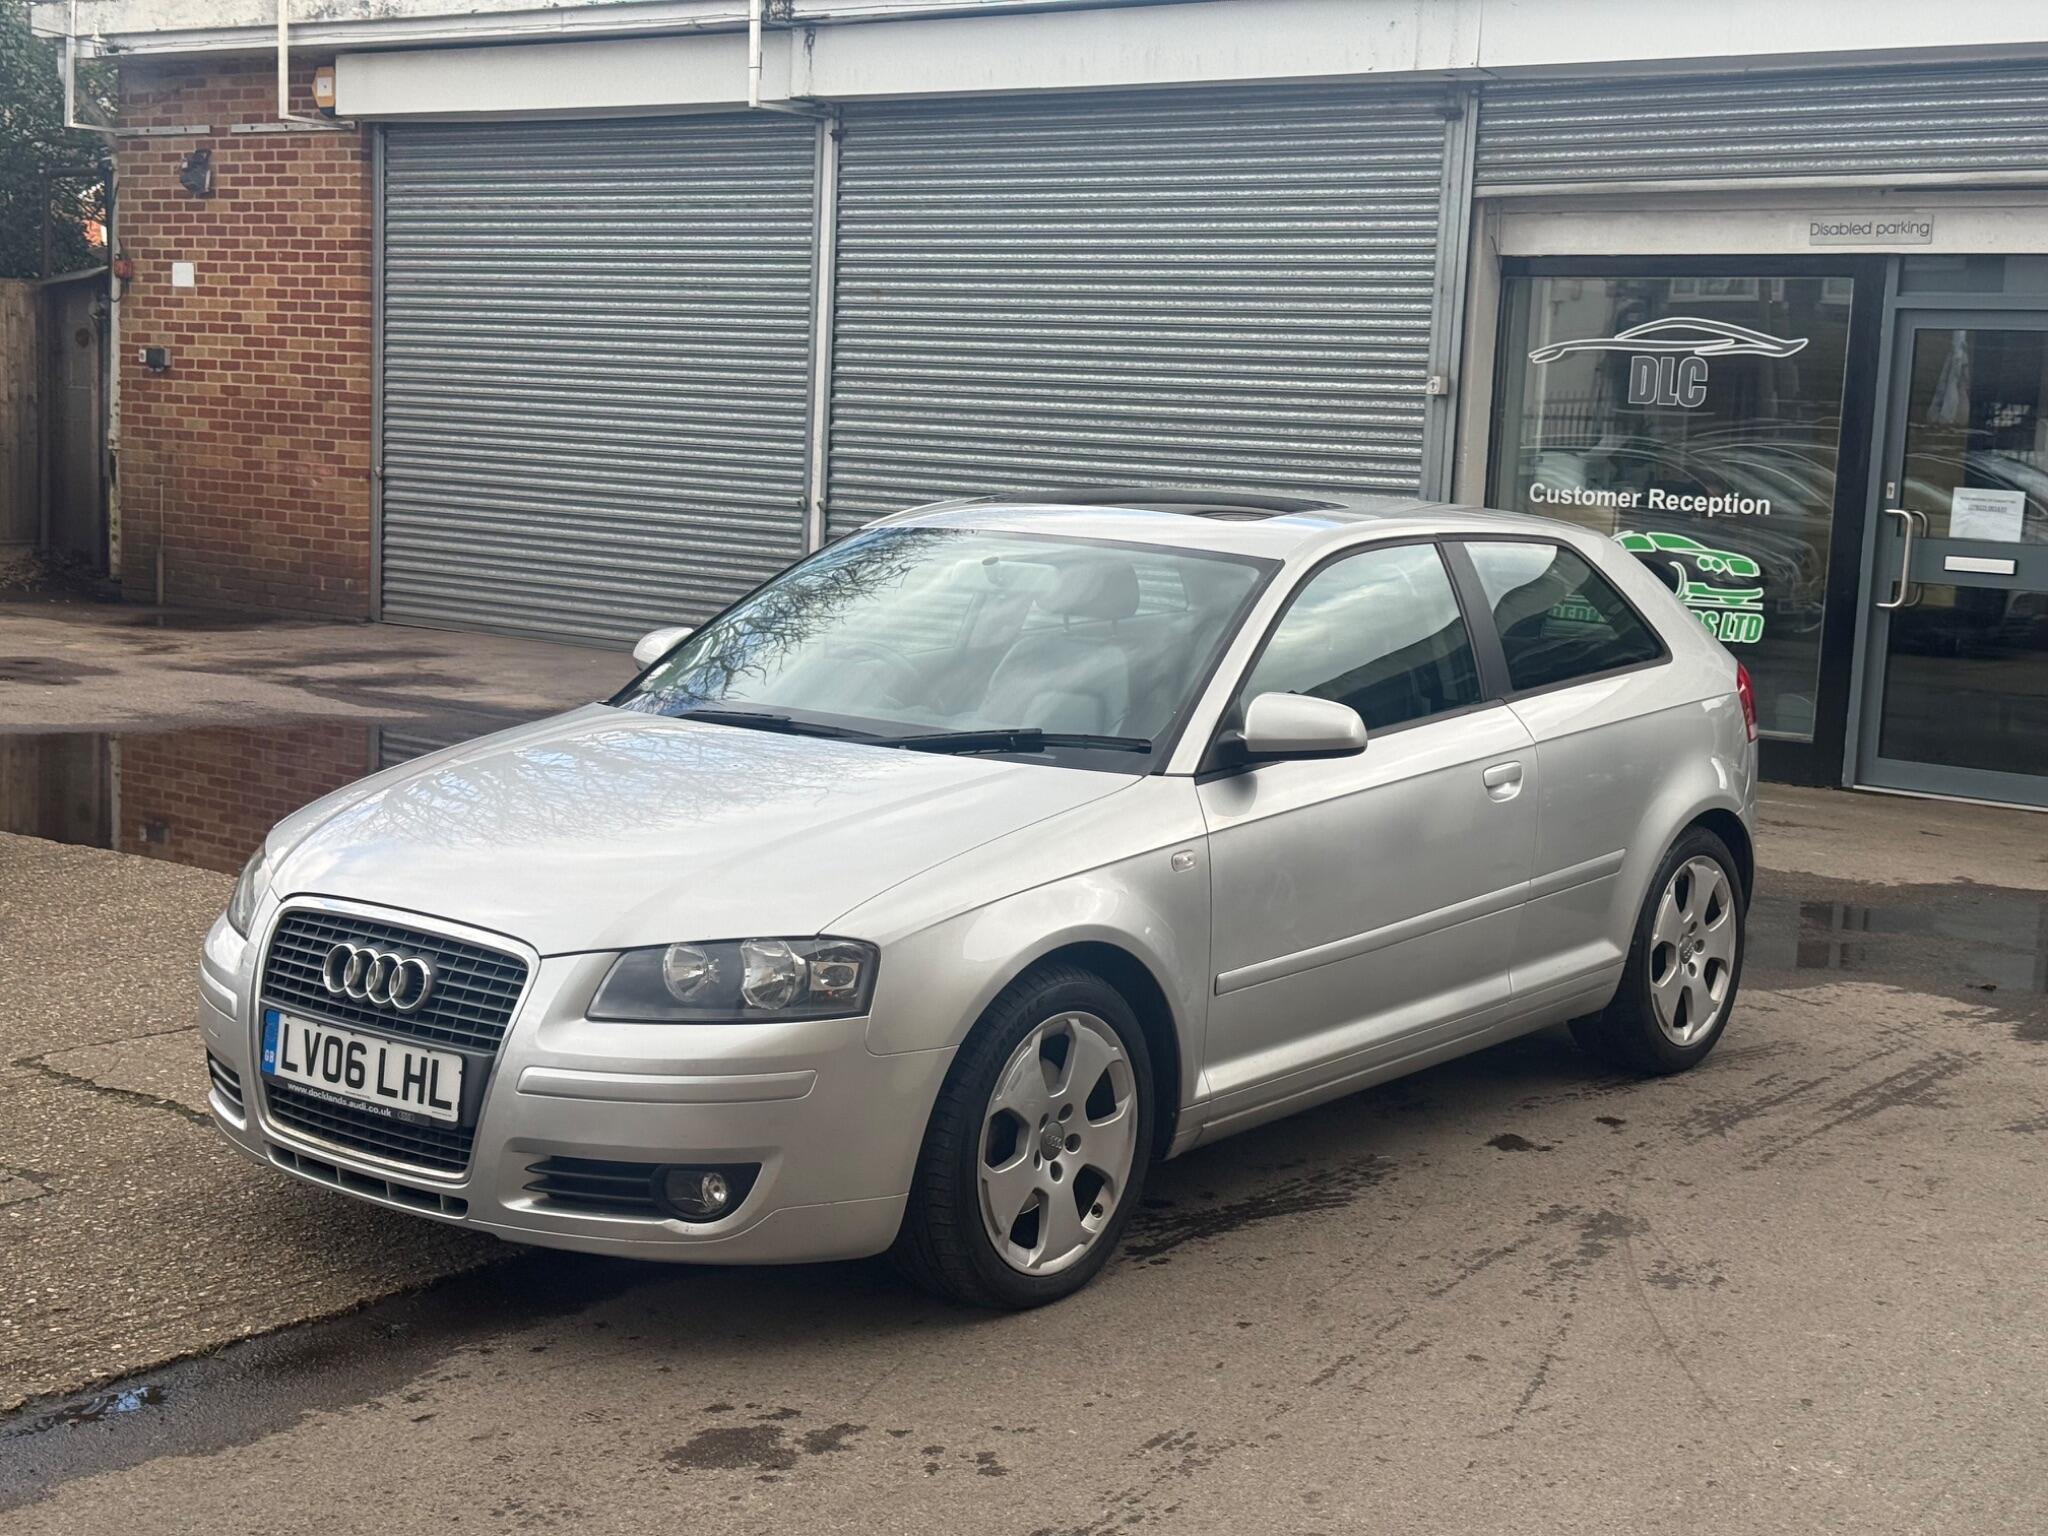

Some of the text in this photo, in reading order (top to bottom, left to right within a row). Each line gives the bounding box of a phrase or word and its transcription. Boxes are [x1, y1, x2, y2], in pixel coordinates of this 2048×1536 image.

[1809, 220, 1930, 238] Disabled parking
[1628, 355, 1709, 408] DLC
[1529, 482, 1771, 517] Customer Reception
[1718, 612, 1765, 644] LTD
[264, 1049, 275, 1063] GB
[281, 1023, 452, 1111] LV06 LHL
